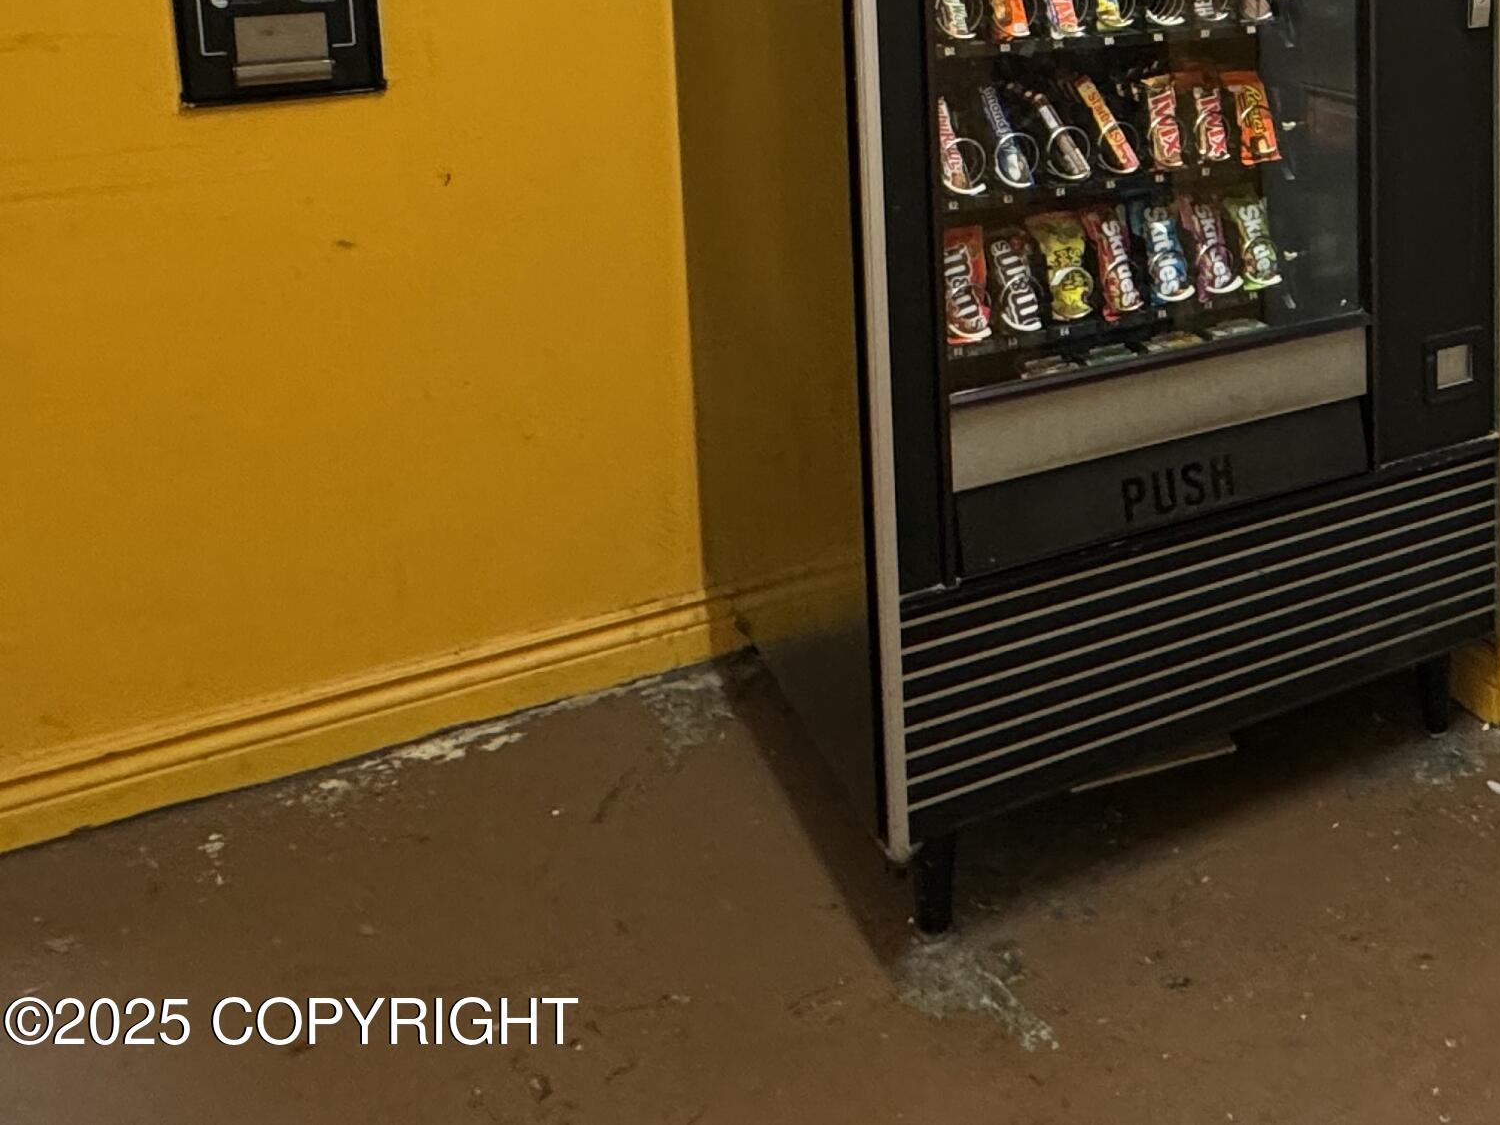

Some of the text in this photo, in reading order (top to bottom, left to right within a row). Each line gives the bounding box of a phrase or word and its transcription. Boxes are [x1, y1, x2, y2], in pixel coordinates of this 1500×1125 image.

[1150, 90, 1181, 158] TWIX
[1199, 96, 1228, 157] TWIX
[1121, 453, 1235, 523] PUSH
